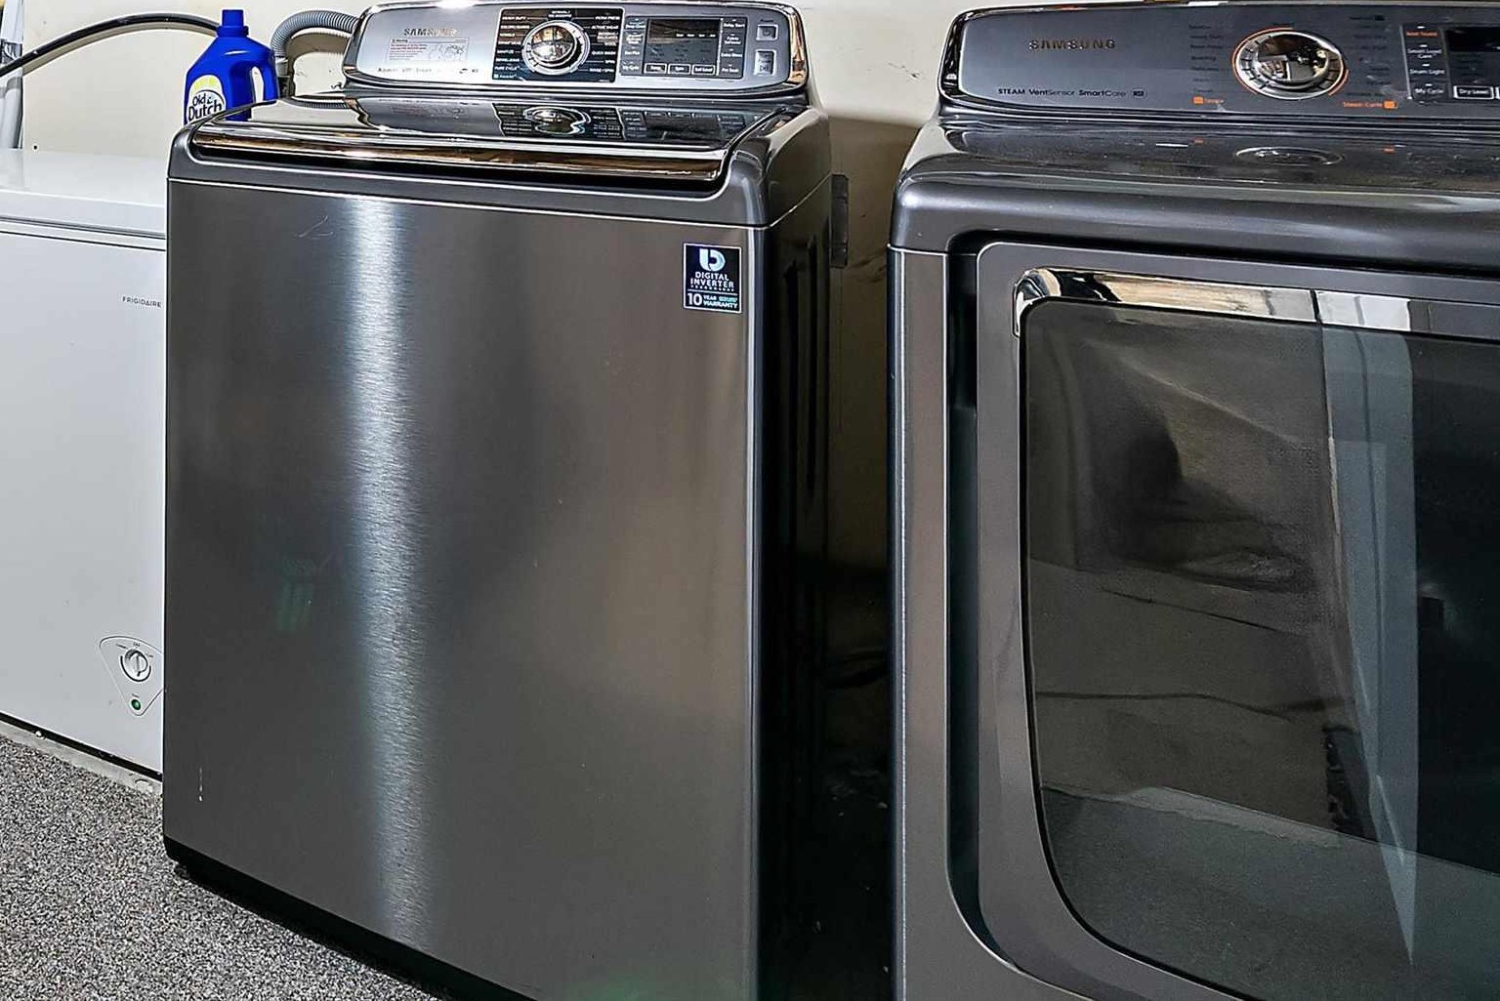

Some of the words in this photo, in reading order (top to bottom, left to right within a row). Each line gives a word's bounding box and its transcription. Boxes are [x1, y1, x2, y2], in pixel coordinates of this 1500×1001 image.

[1029, 38, 1116, 49] SAMSUNG
[192, 92, 207, 106] Old
[188, 99, 222, 121] Dutch
[695, 271, 729, 281] DIGITAL
[690, 278, 734, 288] INVERTER
[687, 293, 703, 306] 10
[703, 300, 738, 309] WARRANTY
